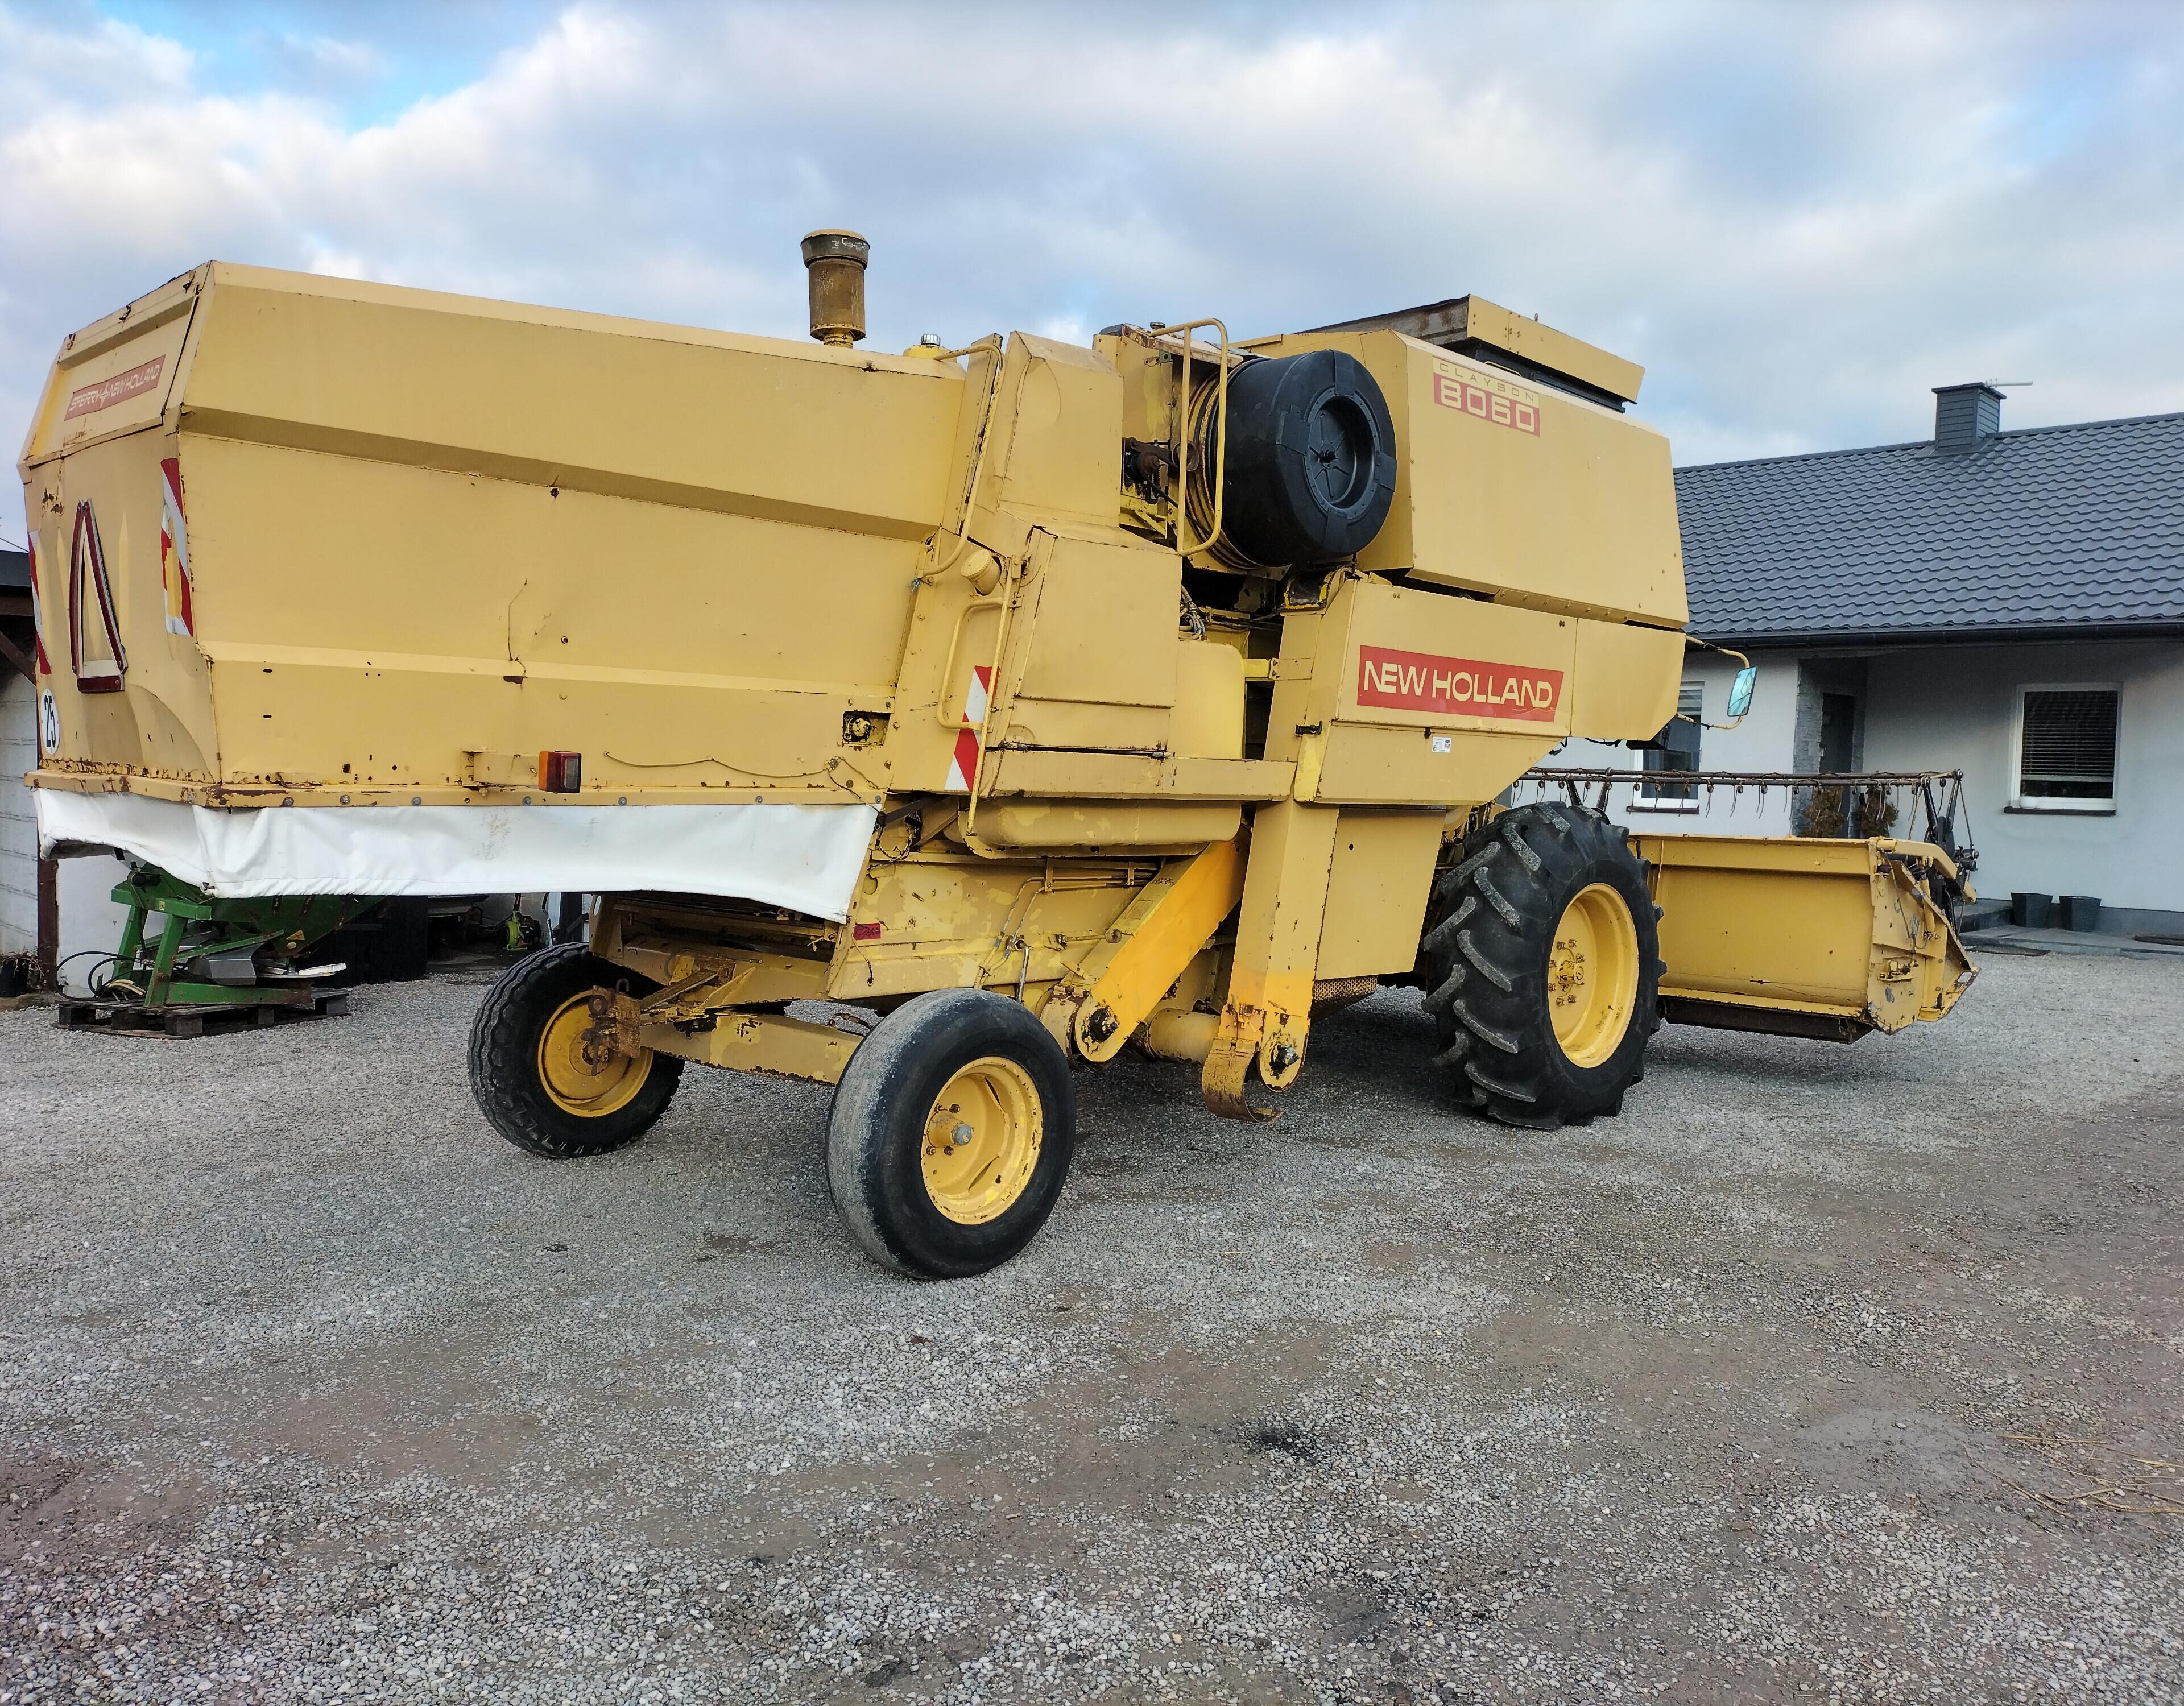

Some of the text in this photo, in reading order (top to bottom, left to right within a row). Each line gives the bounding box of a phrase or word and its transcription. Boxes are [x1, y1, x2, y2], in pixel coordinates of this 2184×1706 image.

[69, 364, 160, 411] SPERRY NEW HOLLAND
[1440, 362, 1533, 402] CLAYSON
[1440, 377, 1535, 433] 8060
[1363, 660, 1553, 709] NEW HOLLAND
[44, 695, 56, 748] 25
